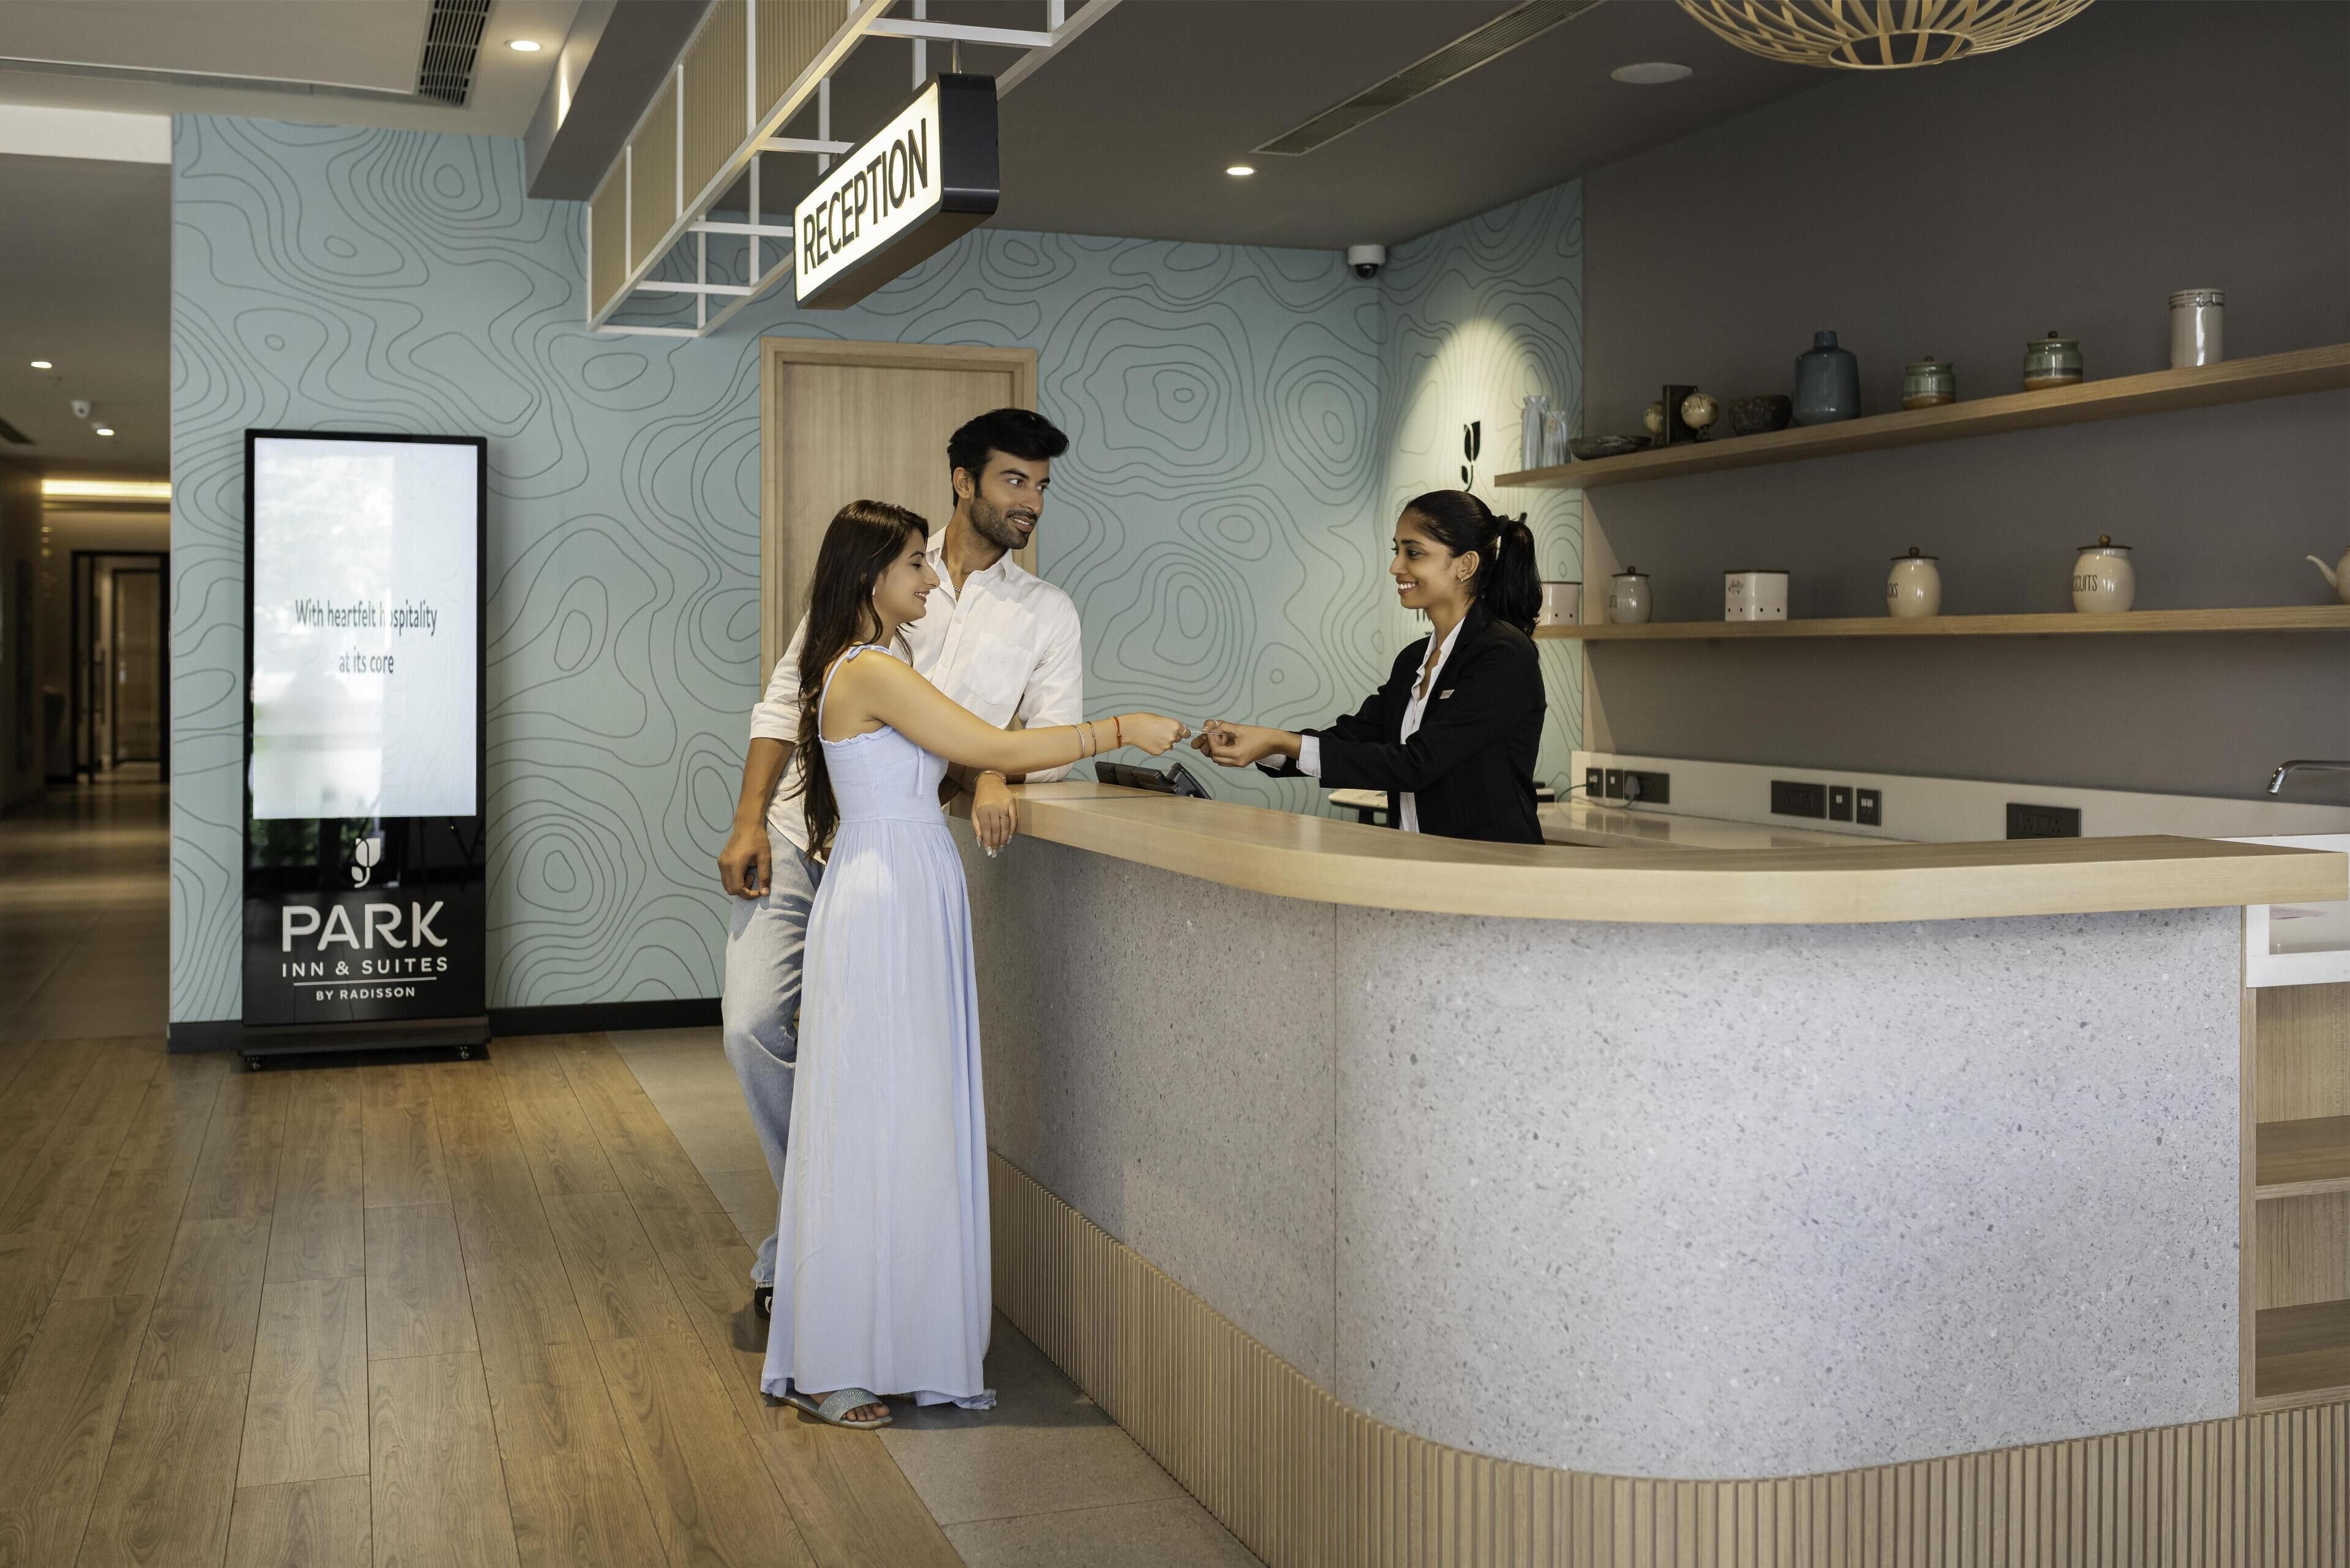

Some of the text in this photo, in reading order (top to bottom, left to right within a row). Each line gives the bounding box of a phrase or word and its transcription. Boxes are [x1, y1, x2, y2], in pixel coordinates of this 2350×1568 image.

[804, 118, 928, 275] RECEPTION
[295, 599, 324, 627] With
[327, 600, 376, 627] heartfelt
[340, 646, 394, 674] at its core
[282, 901, 447, 952] PARK
[282, 957, 447, 977] INN & SUITES
[316, 987, 415, 1001] BY RADISSON
